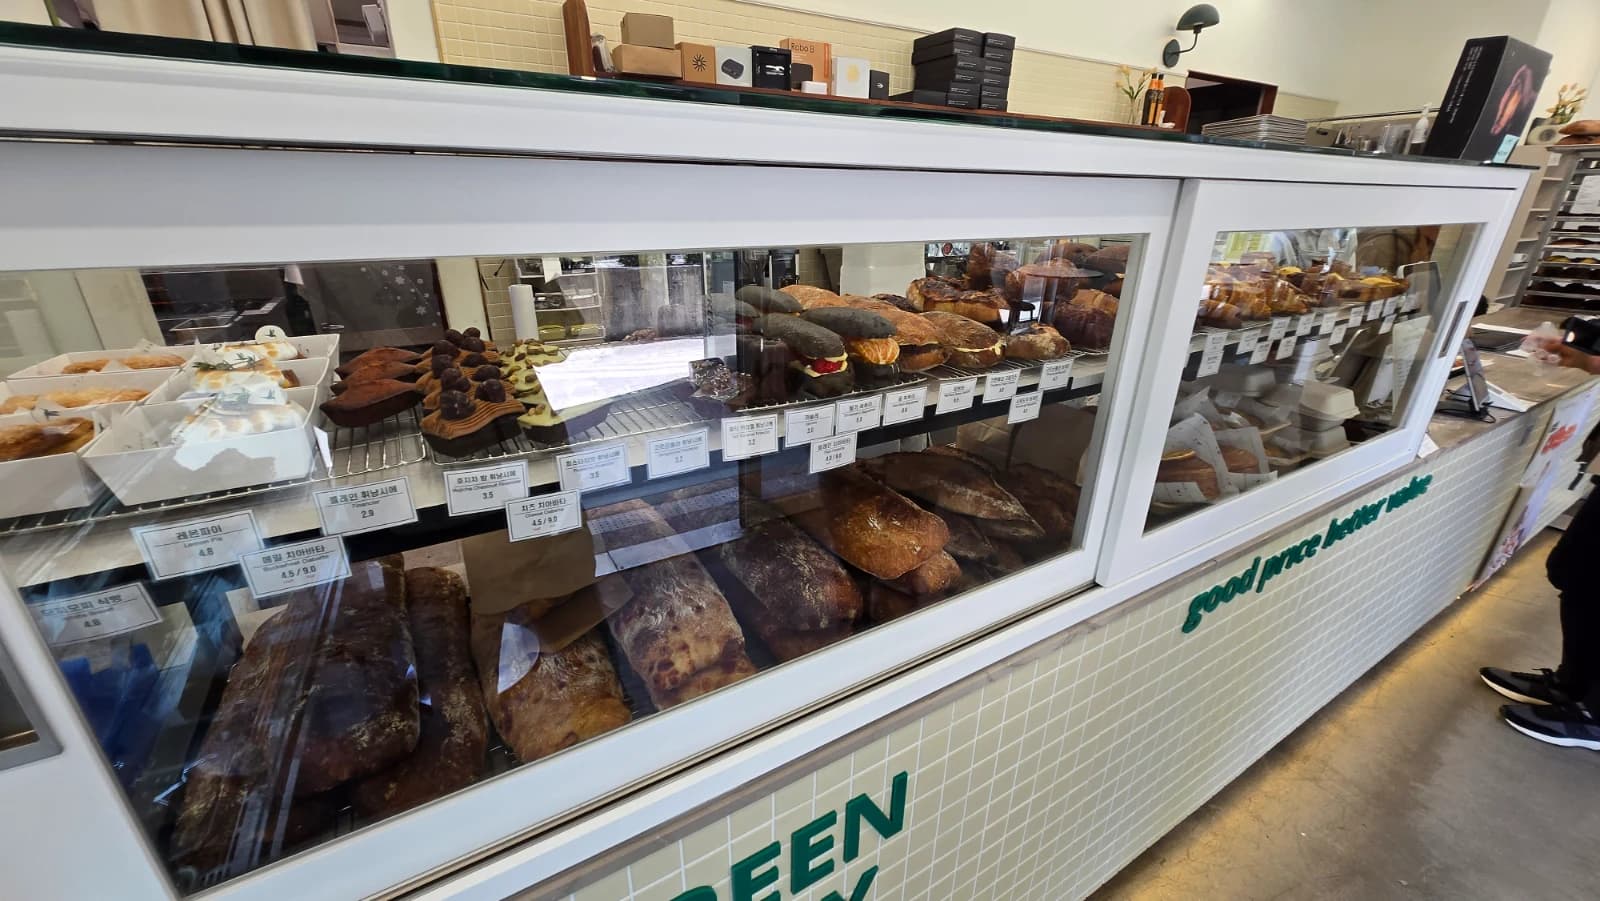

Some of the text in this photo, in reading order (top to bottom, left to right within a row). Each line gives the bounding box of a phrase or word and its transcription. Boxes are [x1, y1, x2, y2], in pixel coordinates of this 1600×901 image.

[361, 485, 398, 498] 휘낭시에
[538, 498, 566, 509] 치아바타
[176, 524, 223, 540] 레몬파이
[286, 545, 325, 558] 치아바타
[302, 565, 316, 574] 9.0
[1182, 556, 1261, 634] good
[1321, 497, 1388, 549] better
[669, 770, 908, 901] EEN
